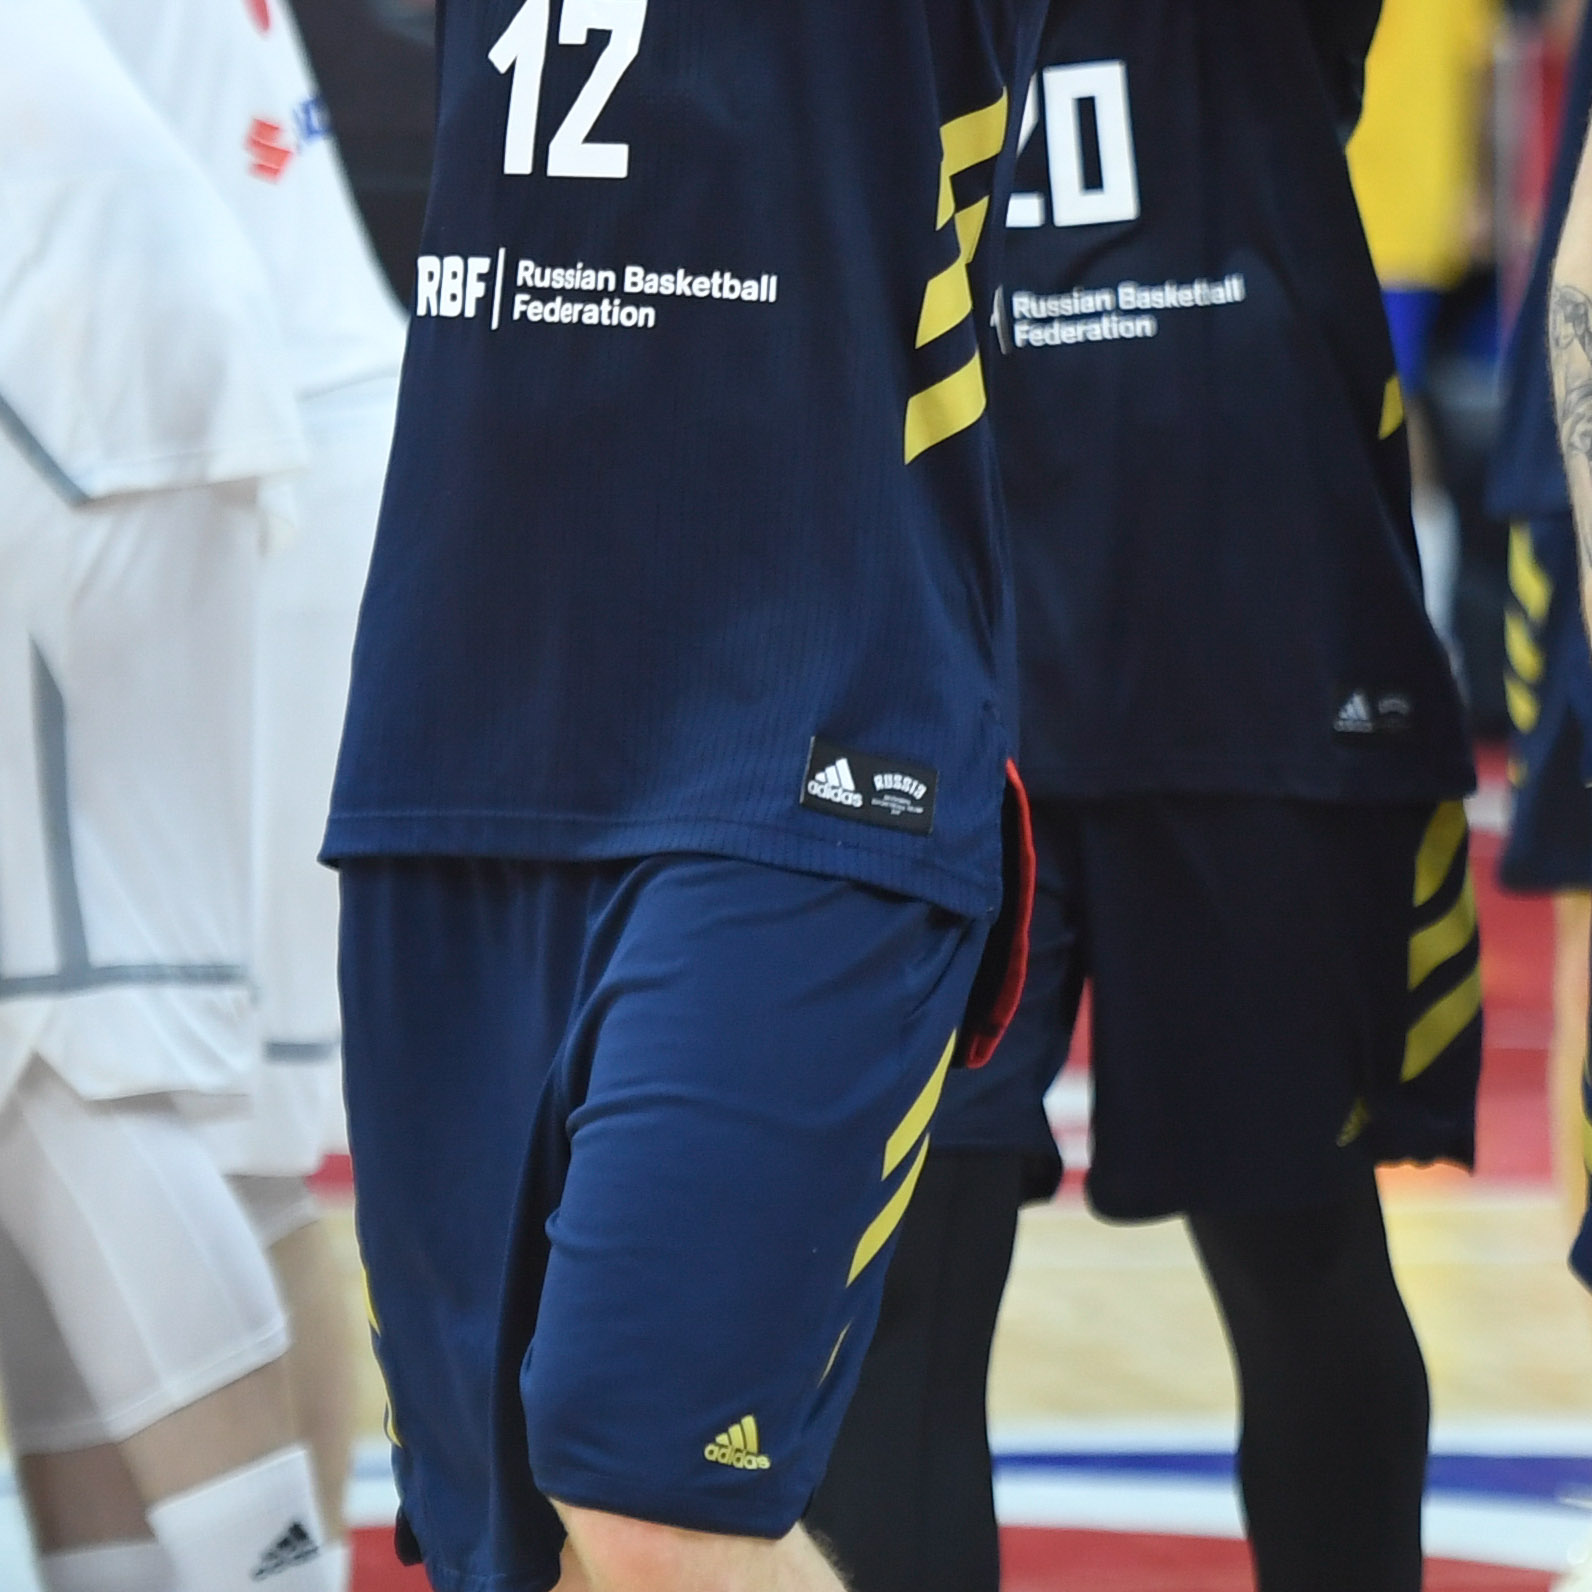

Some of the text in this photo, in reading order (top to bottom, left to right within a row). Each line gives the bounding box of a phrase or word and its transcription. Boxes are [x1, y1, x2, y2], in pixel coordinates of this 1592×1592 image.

[415, 255, 491, 318] RBF
[515, 259, 778, 303] Russian Basketball
[512, 293, 656, 329] Federation
[1012, 285, 1116, 319] Russian
[1013, 312, 1158, 348] Federation
[807, 779, 863, 808] adidas
[705, 1443, 770, 1469] adidas
